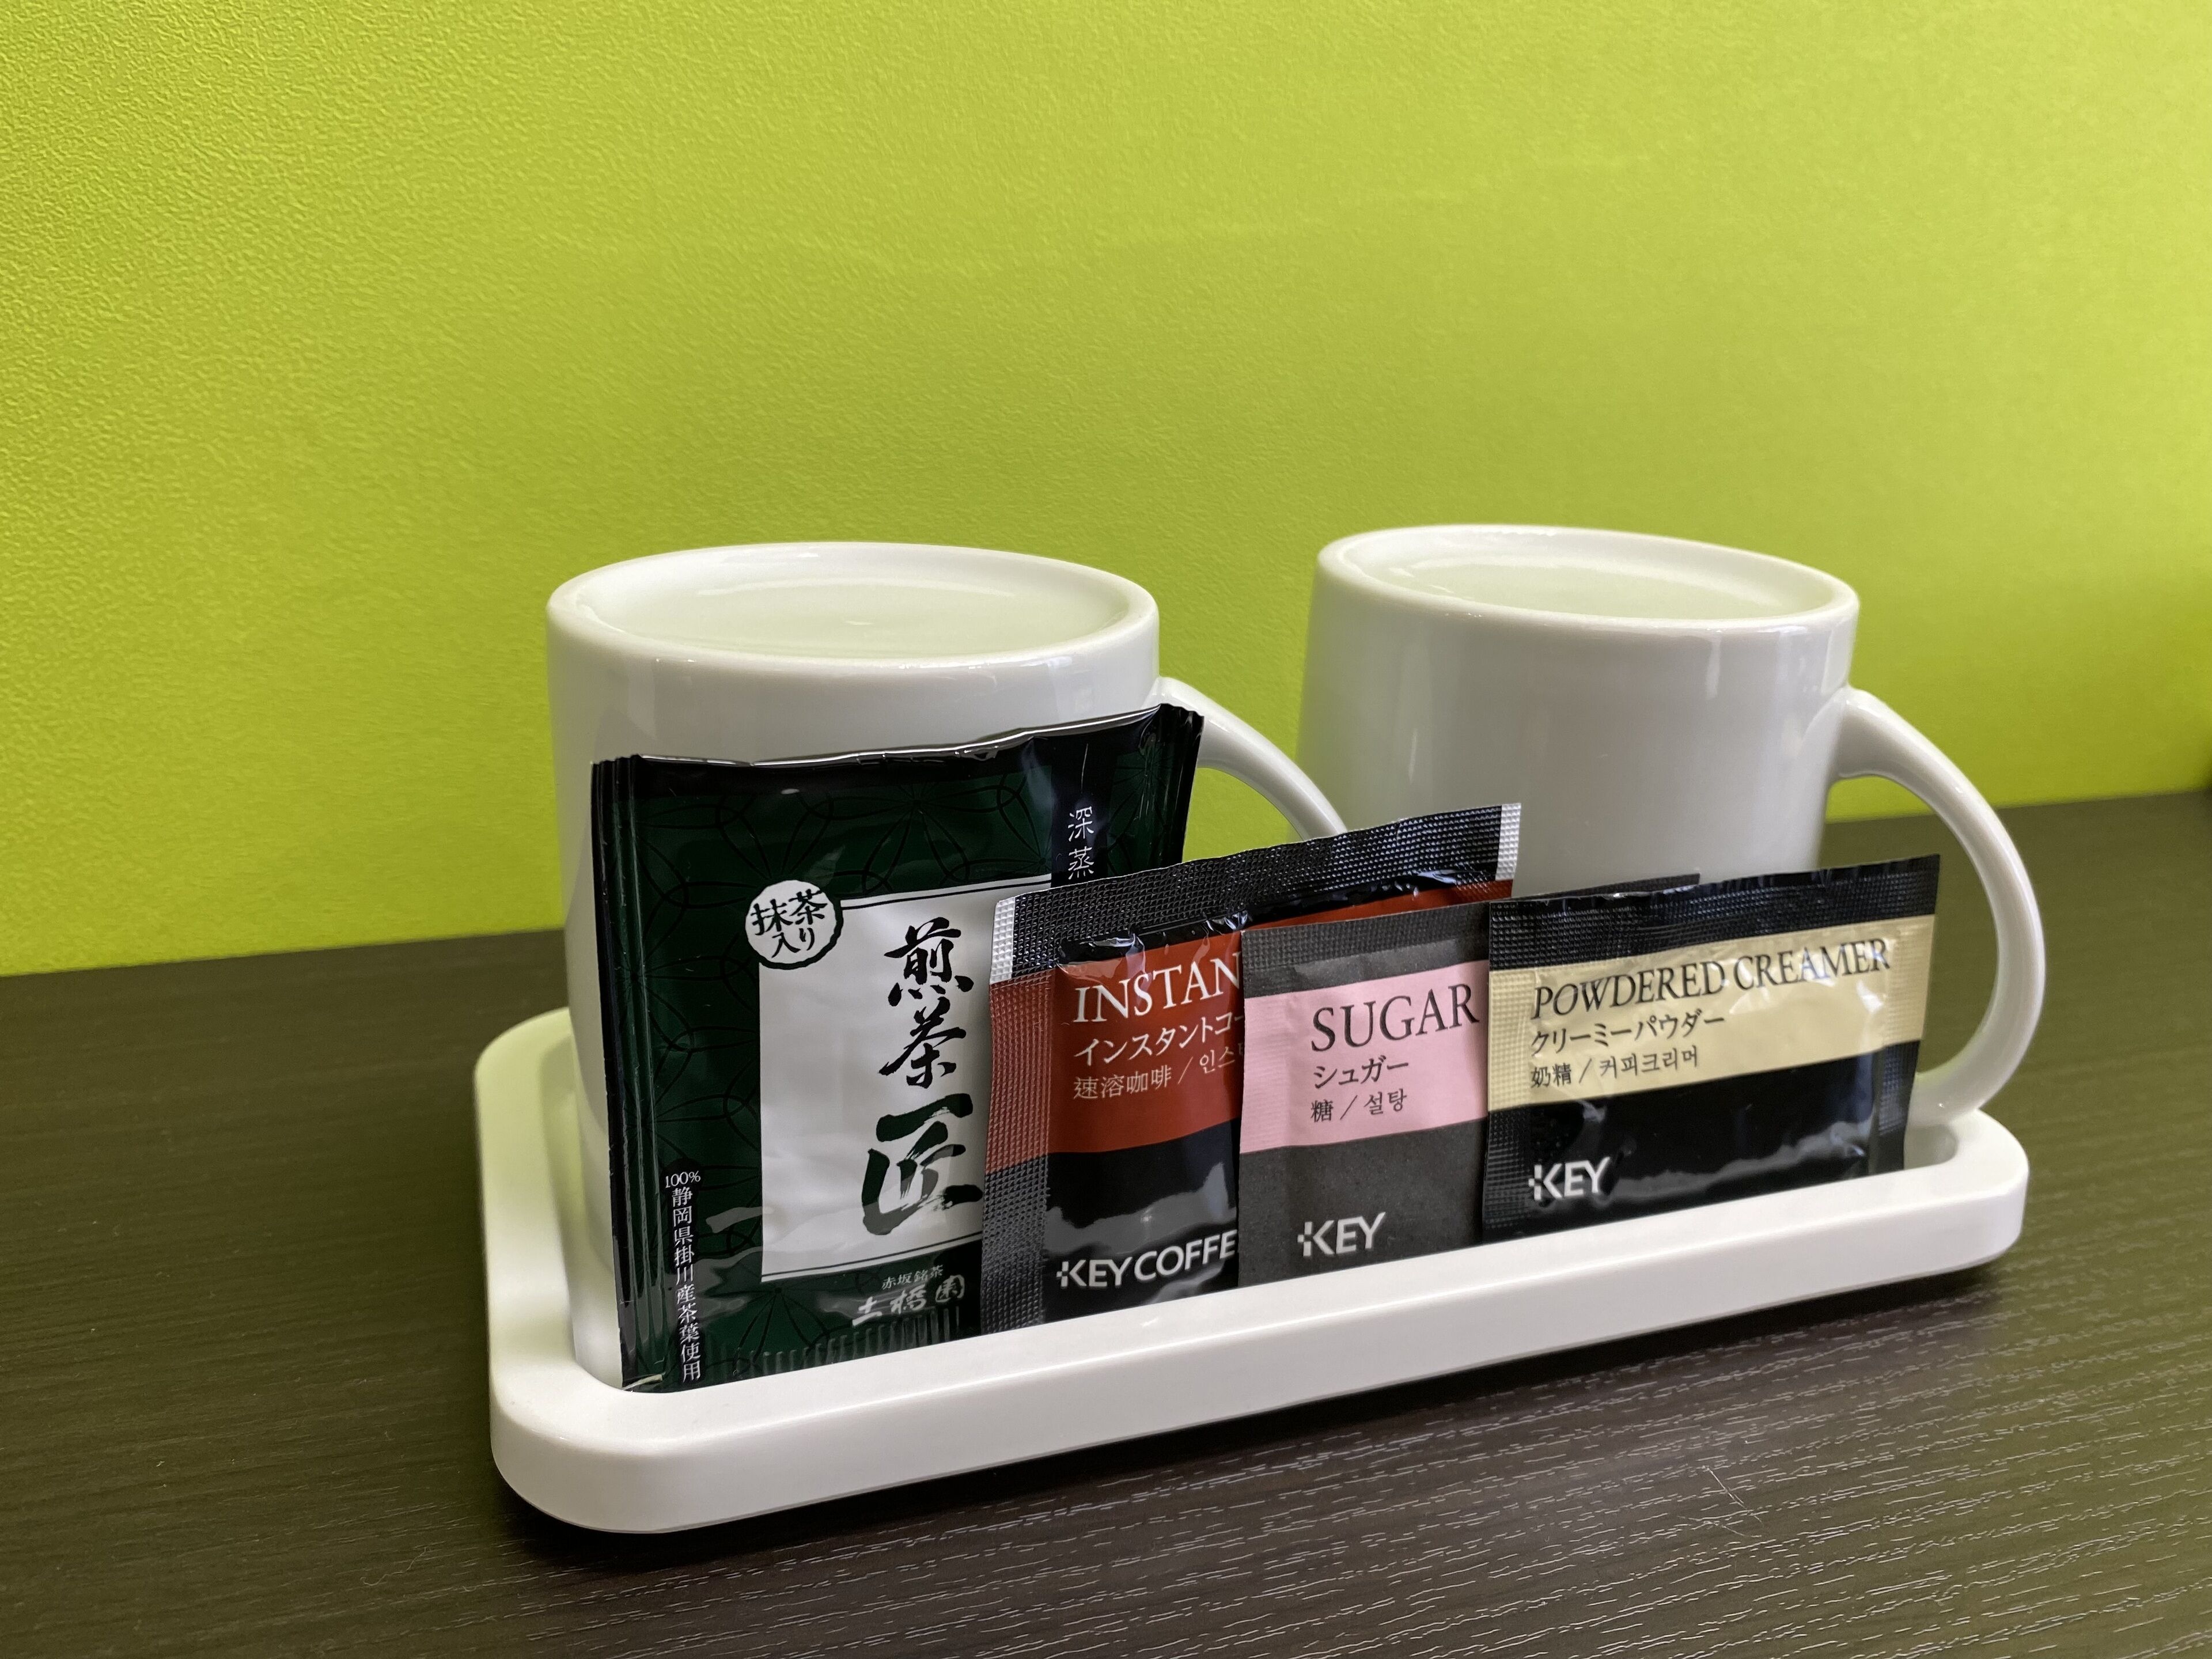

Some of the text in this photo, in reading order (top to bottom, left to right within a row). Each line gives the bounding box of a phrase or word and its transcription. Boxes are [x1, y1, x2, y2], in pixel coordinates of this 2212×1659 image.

[1067, 806, 1094, 880] 深蒸
[751, 889, 827, 935] 抹茶
[771, 929, 815, 959] 入り
[1529, 937, 1891, 1020] POWDERED CREAMER
[1310, 983, 1480, 1052] SUGAR
[1529, 1009, 1726, 1056] クリーミーパウダー
[1313, 1055, 1409, 1089] シュガー
[1529, 1063, 1573, 1089] 奶精
[1599, 1044, 1699, 1078] 커피크리머
[1073, 1065, 1172, 1100] 速溶咖啡
[1363, 1088, 1408, 1116] 설탕
[1310, 1100, 1334, 1123] 糖
[1528, 1156, 1611, 1202] KEY
[1297, 1211, 1386, 1257] KEY
